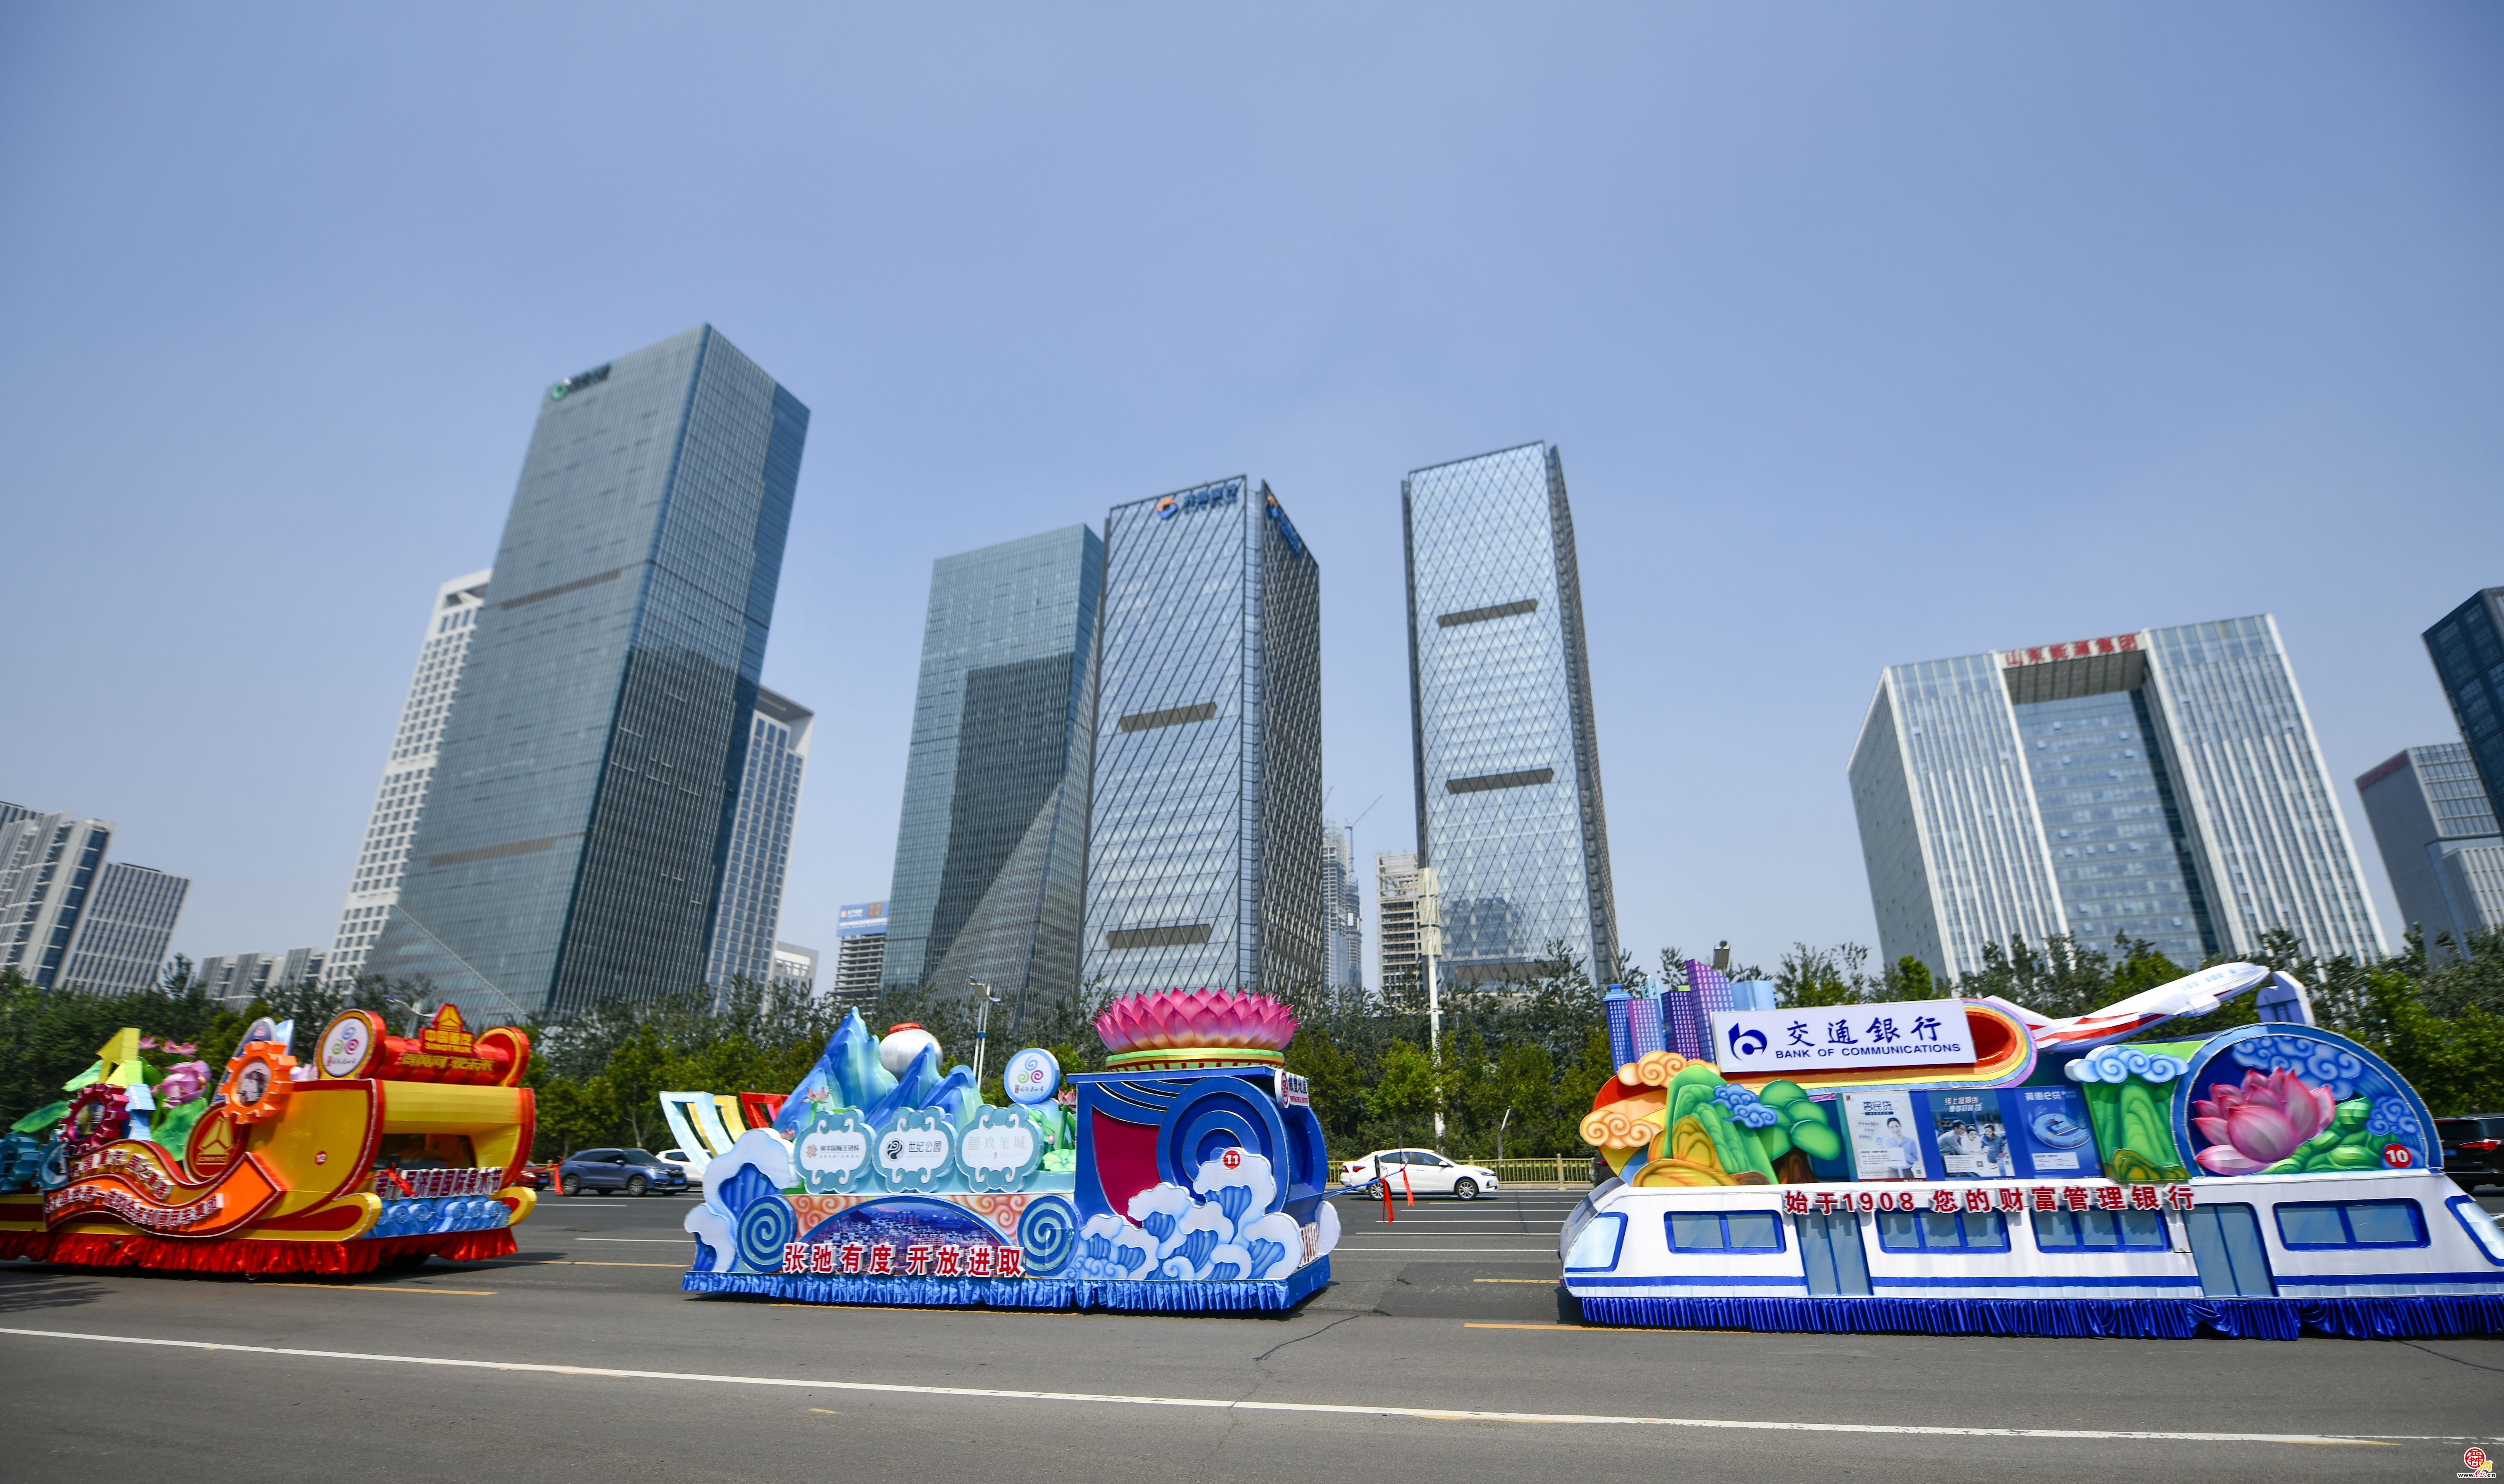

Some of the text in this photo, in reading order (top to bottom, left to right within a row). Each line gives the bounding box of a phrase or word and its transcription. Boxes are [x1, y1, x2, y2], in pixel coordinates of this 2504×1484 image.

[425, 1042, 473, 1054] SINOTRUK
[1776, 1043, 1961, 1059] BANK OF COMMUNICATIONS
[1863, 1101, 1893, 1111] 惠民贷
[909, 1141, 941, 1152] 世纪公园
[316, 1154, 326, 1162] 12
[1225, 1154, 1239, 1165] 11
[2386, 1150, 2409, 1162] 10
[1785, 1185, 2194, 1215] 始于1908 您的财富管理银行
[783, 1243, 1024, 1277] 张弛有度 开放进取
